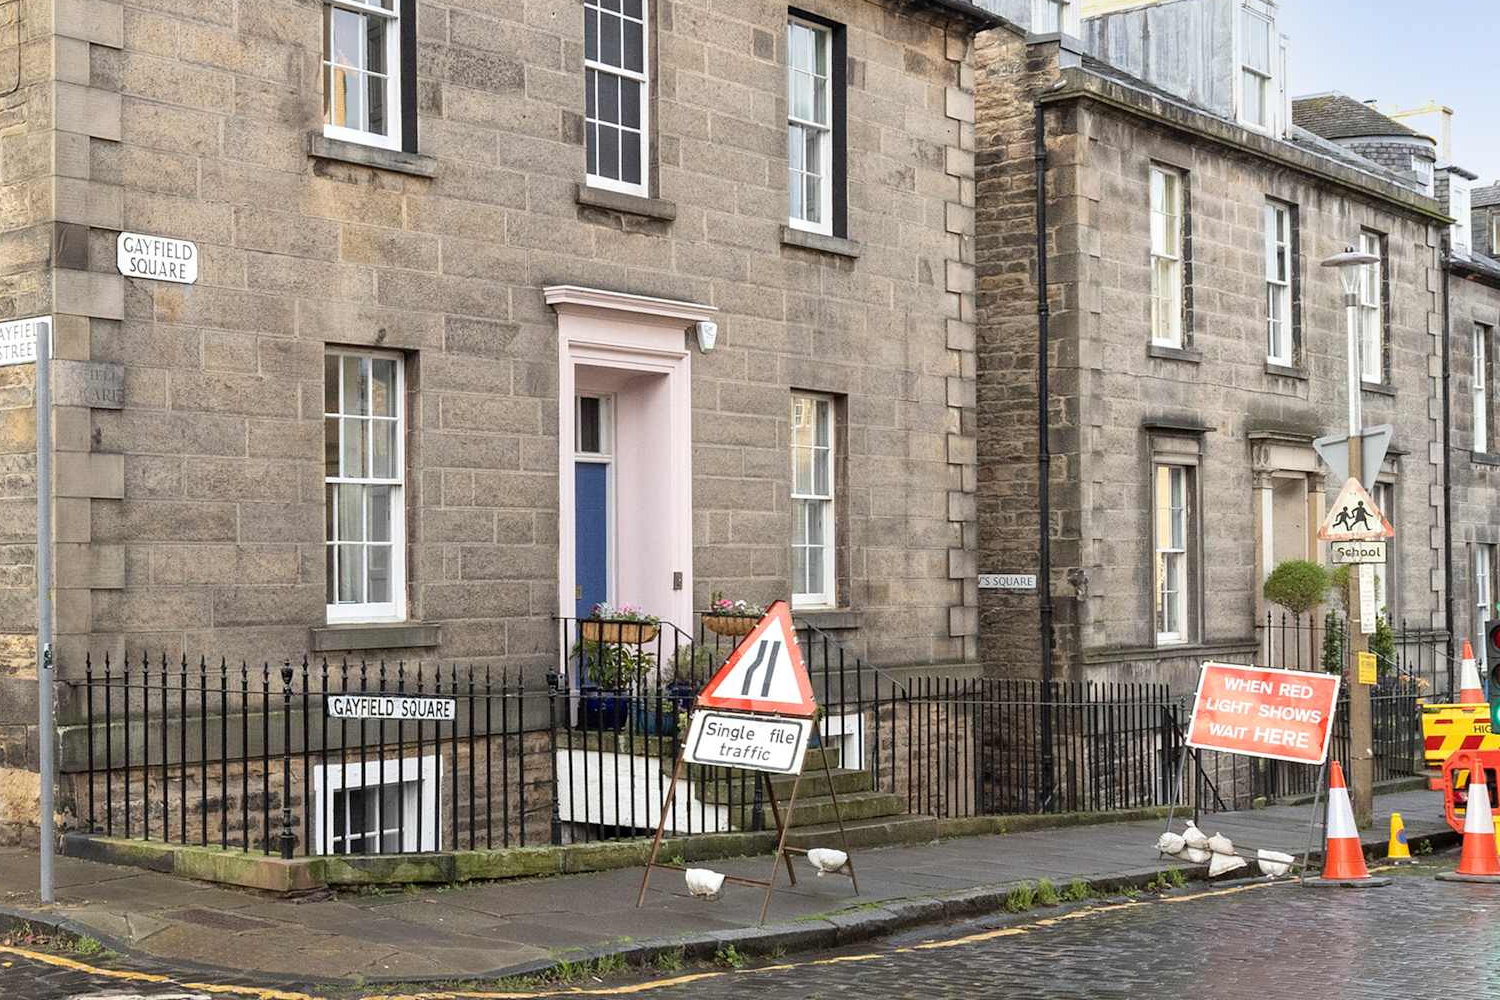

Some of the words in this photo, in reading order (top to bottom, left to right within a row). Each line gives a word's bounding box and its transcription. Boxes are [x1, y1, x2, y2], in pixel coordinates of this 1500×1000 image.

[123, 237, 193, 260] GAYFIELD
[129, 257, 187, 279] SQUARE
[1337, 547, 1381, 557] School
[993, 576, 1033, 586] SQUARE
[1224, 676, 1273, 695] WHEN
[1279, 683, 1314, 699] RED
[334, 698, 394, 716] GAYFIELD
[401, 700, 450, 718] SQUARE
[1206, 697, 1253, 715] LIGHT
[1259, 704, 1322, 724] SHOWS
[706, 722, 755, 741] Single
[770, 728, 795, 744] file
[1209, 722, 1247, 740] WAIT
[1253, 727, 1310, 748] HERE
[720, 743, 771, 761] traffic
